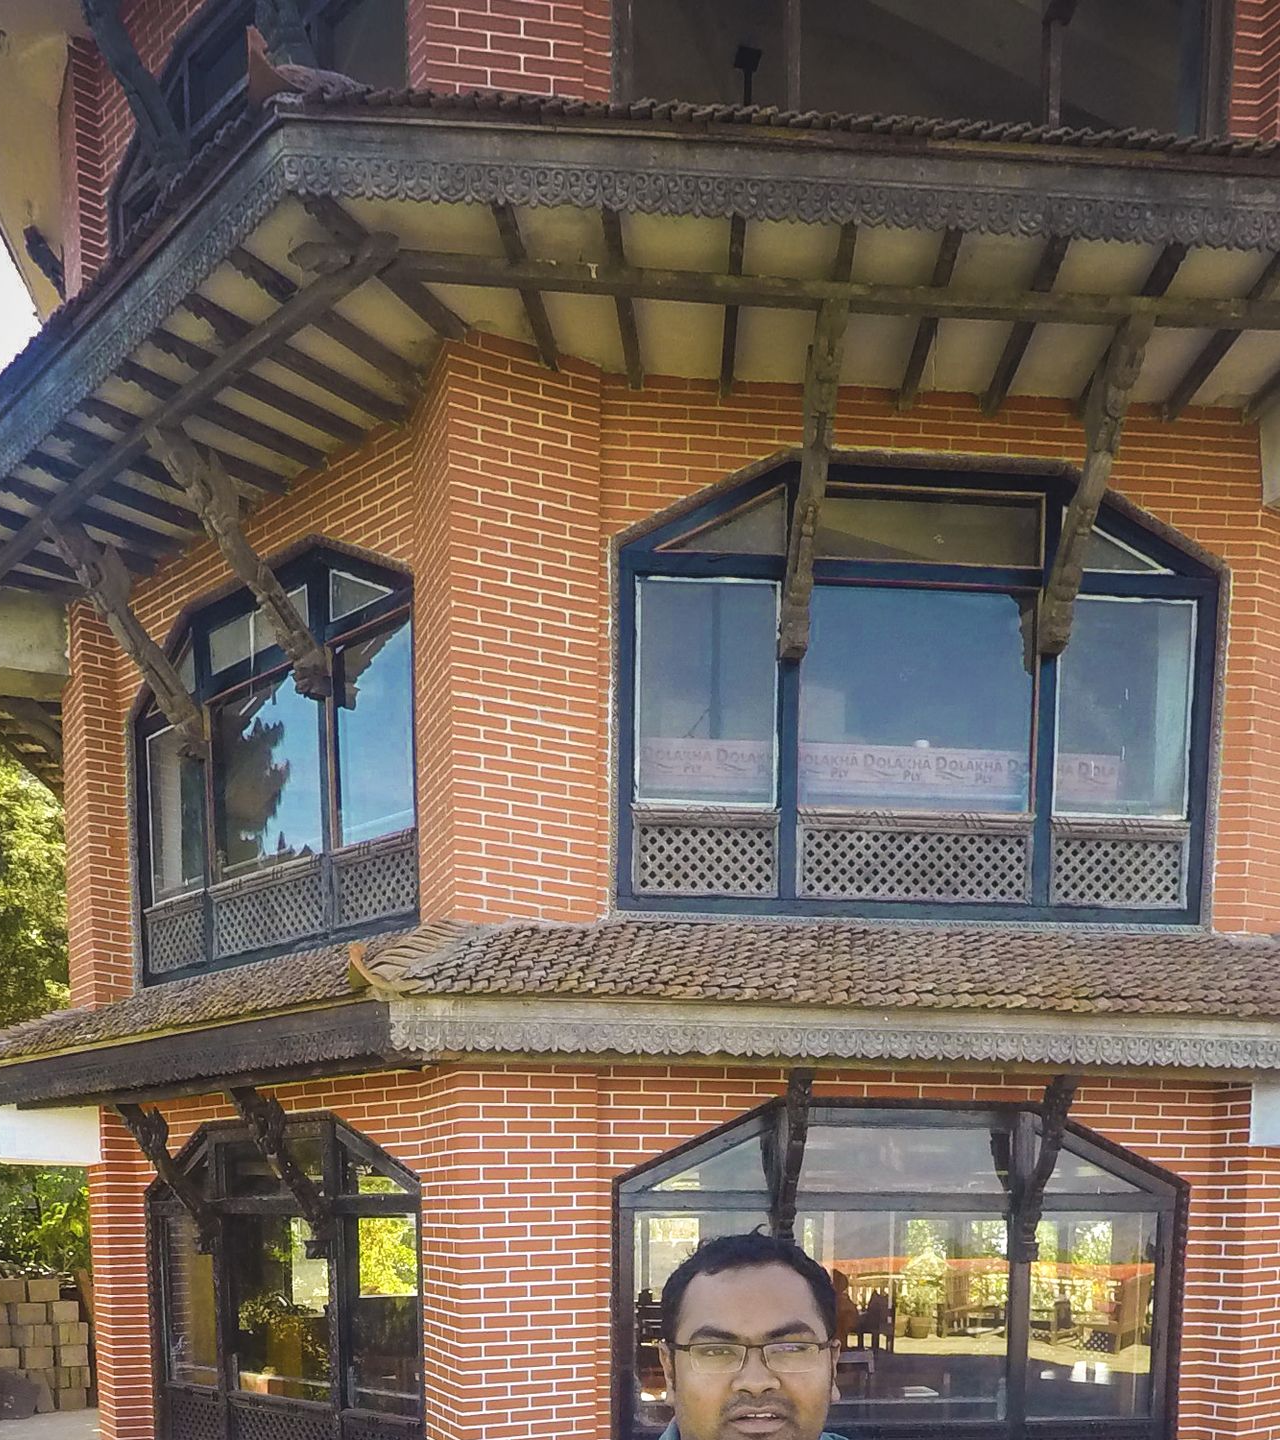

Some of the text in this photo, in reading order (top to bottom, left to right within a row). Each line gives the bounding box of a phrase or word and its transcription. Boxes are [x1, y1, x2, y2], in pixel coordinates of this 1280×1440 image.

[864, 753, 932, 769] DOLAKHA
[936, 756, 1002, 773] DOLAKHA
[830, 766, 849, 778] PLY
[902, 769, 921, 781] PLY
[975, 772, 994, 784] PLY
